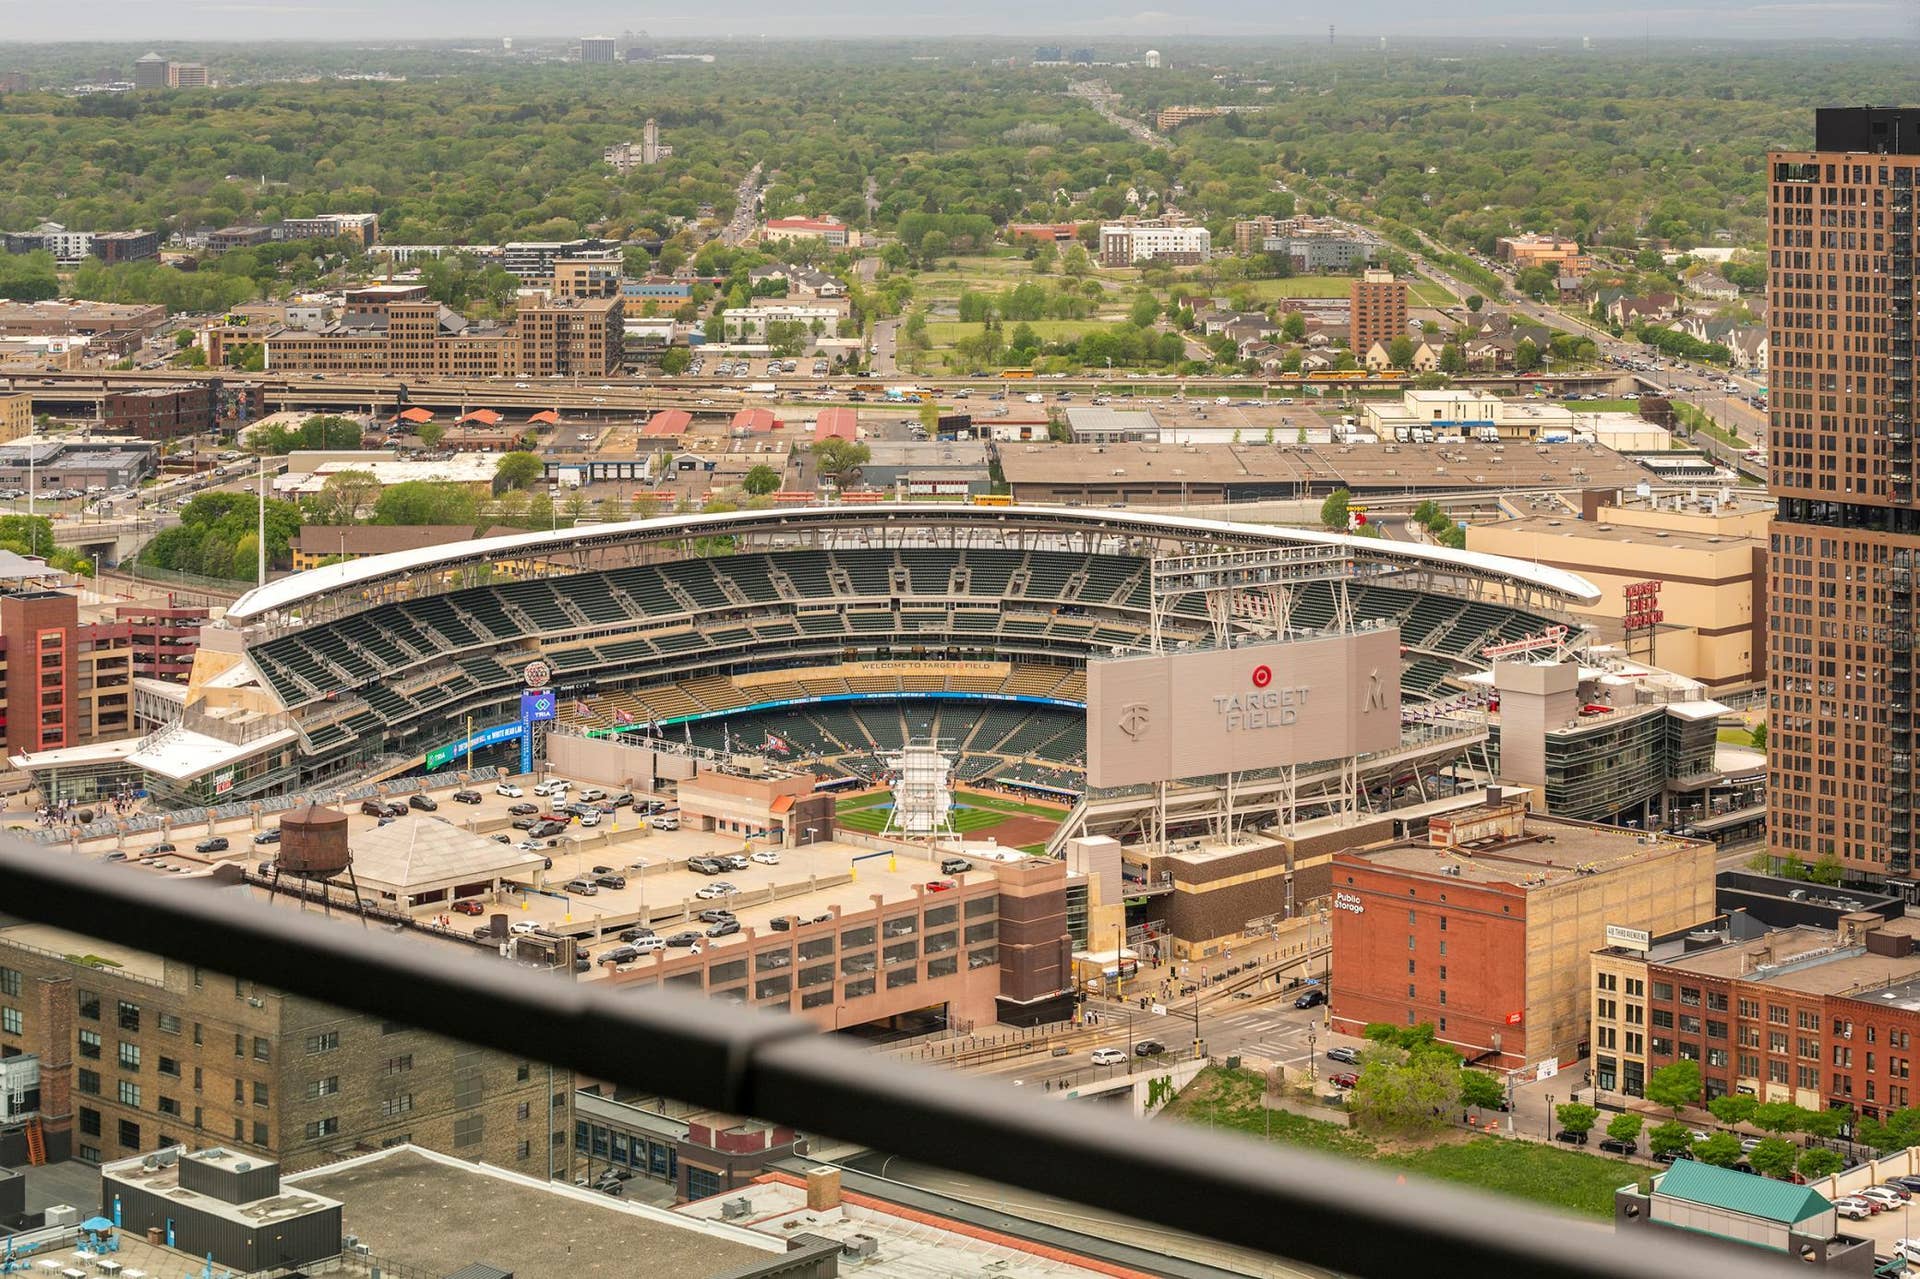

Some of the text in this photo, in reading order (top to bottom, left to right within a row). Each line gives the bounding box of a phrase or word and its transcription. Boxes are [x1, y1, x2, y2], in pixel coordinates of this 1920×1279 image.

[1623, 580, 1663, 597] TARGET
[1629, 597, 1658, 612] FIELD
[1624, 611, 1664, 629] STATION
[1213, 687, 1309, 714] TARGET
[1225, 707, 1297, 732] FIELD
[1337, 892, 1361, 904] Public
[1334, 900, 1364, 914] Storage
